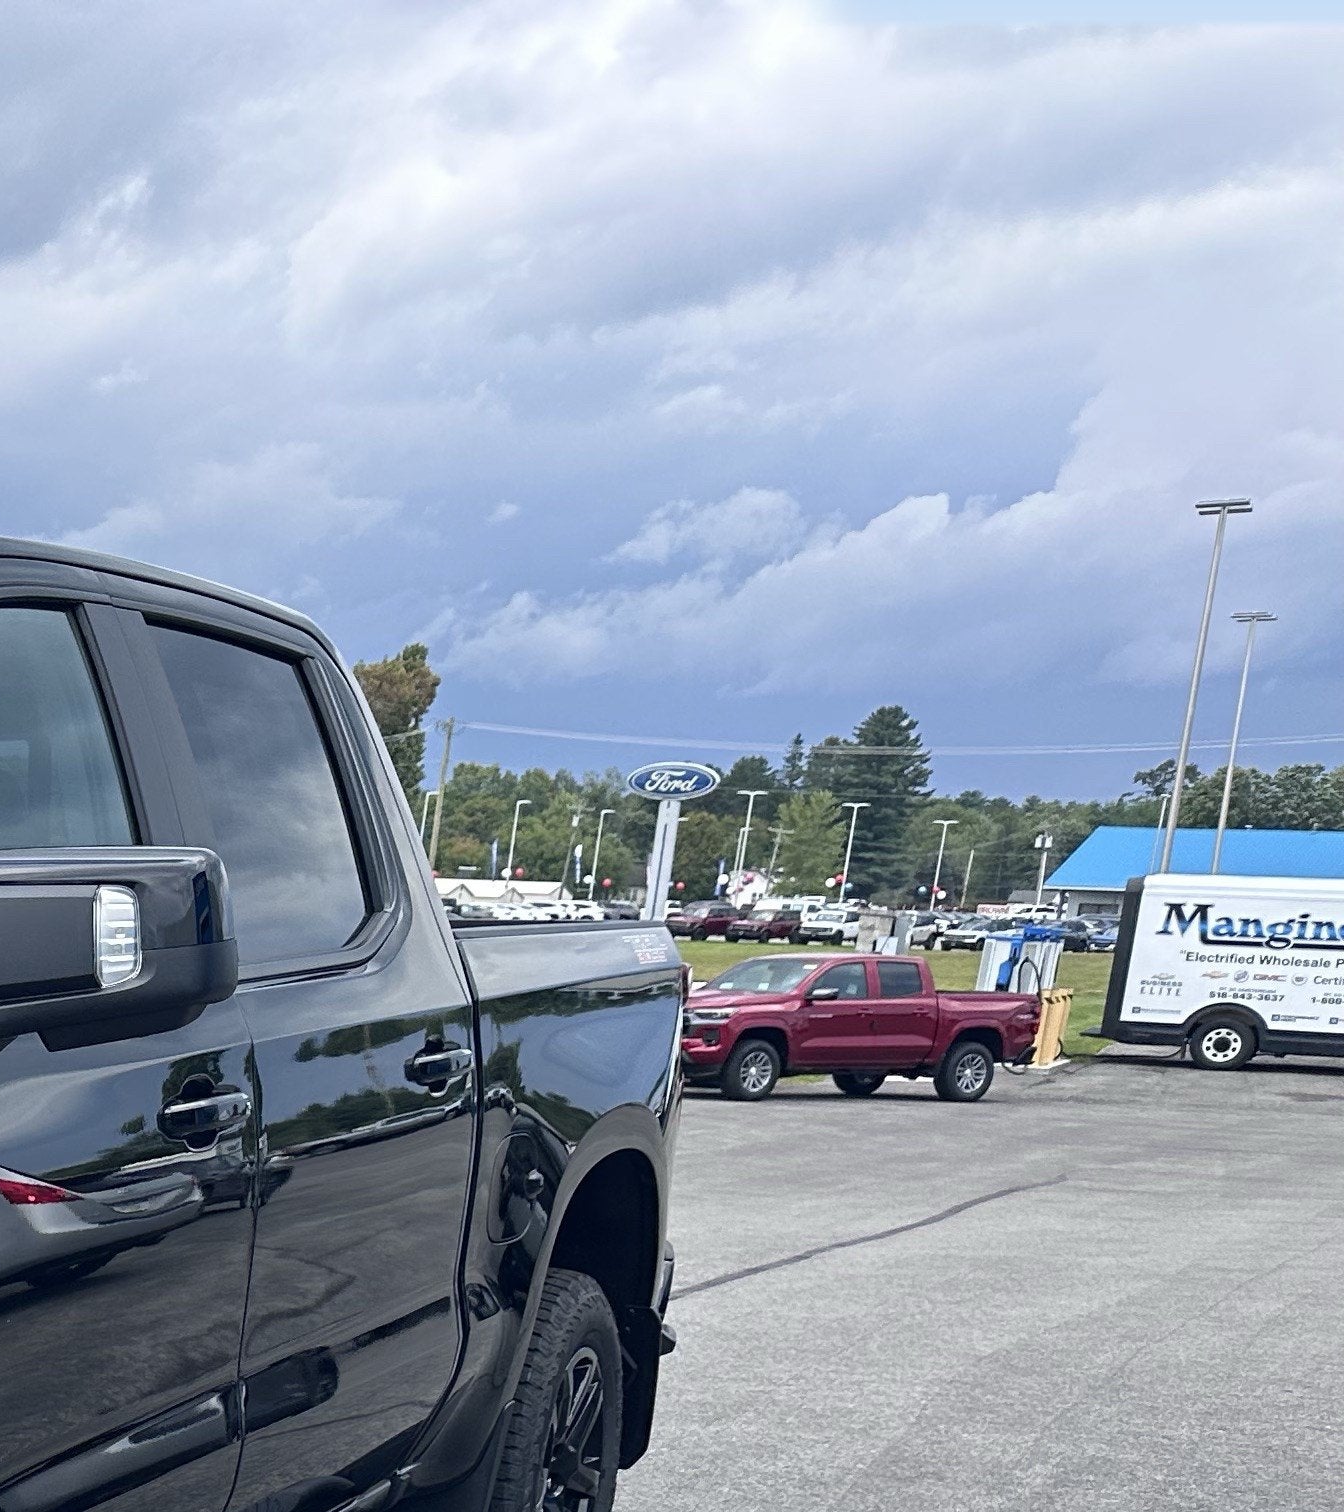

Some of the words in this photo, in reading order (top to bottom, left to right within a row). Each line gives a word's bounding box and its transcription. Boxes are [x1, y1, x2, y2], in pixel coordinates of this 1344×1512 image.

[645, 770, 699, 792] Ford
[1155, 902, 1344, 949] Mangin
[1259, 955, 1331, 968] Wholesale
[1253, 974, 1288, 982] GMC
[1140, 987, 1182, 997] ELITE
